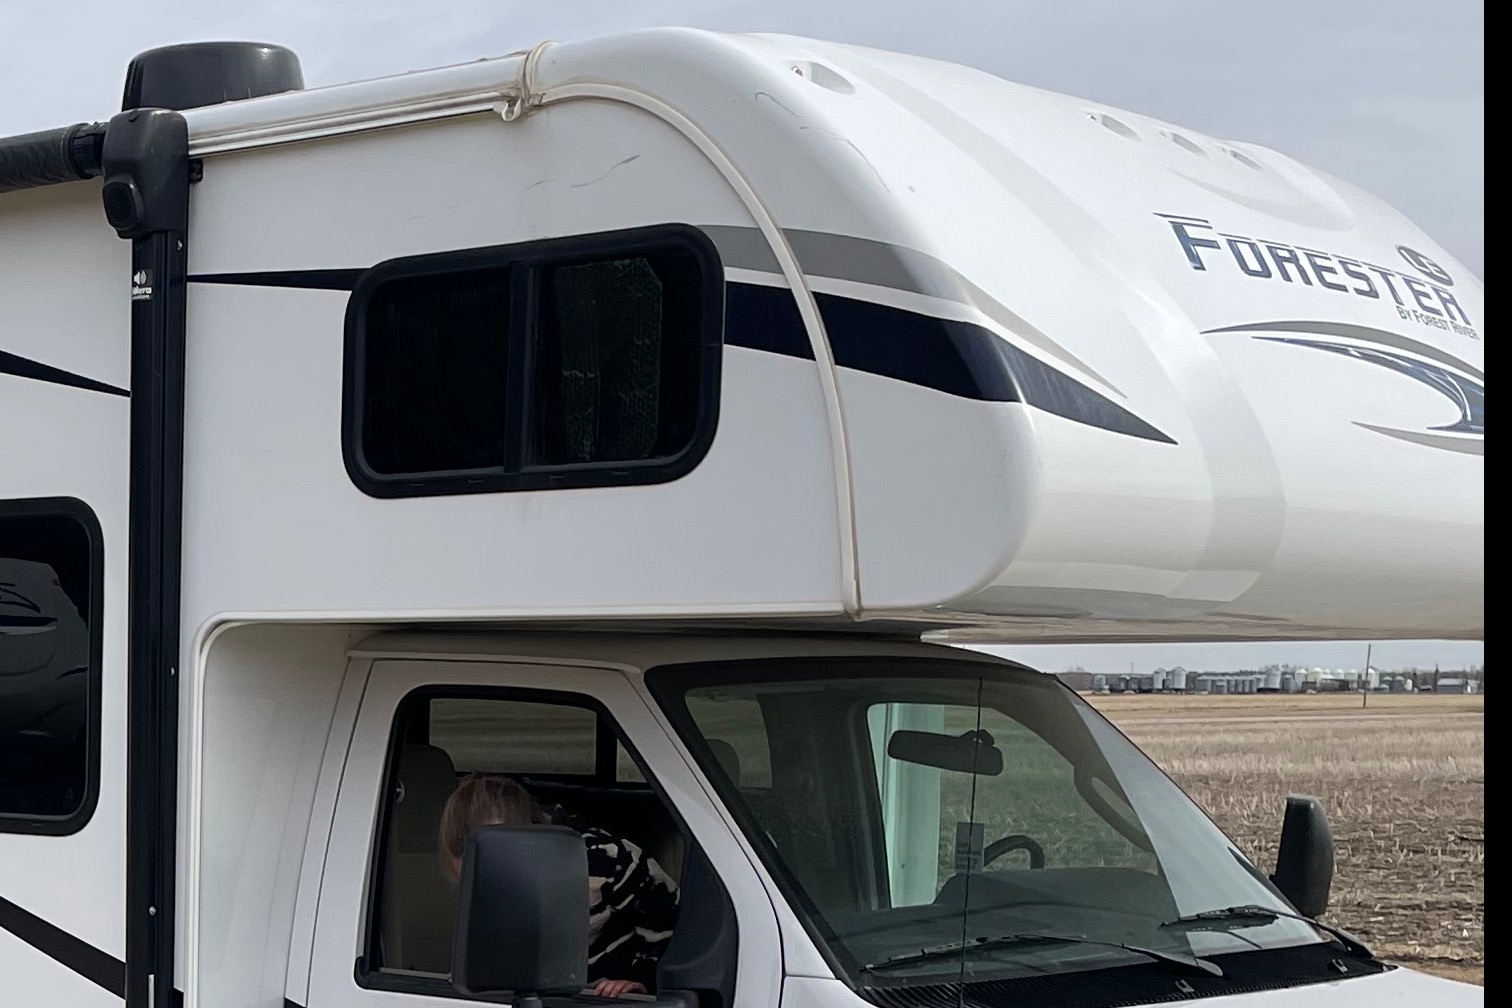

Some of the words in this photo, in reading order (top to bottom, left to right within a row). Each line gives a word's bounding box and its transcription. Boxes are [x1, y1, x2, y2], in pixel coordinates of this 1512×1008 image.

[1153, 212, 1472, 326] FORESTER
[1397, 247, 1452, 283] LE
[1411, 309, 1451, 332] FOREST
